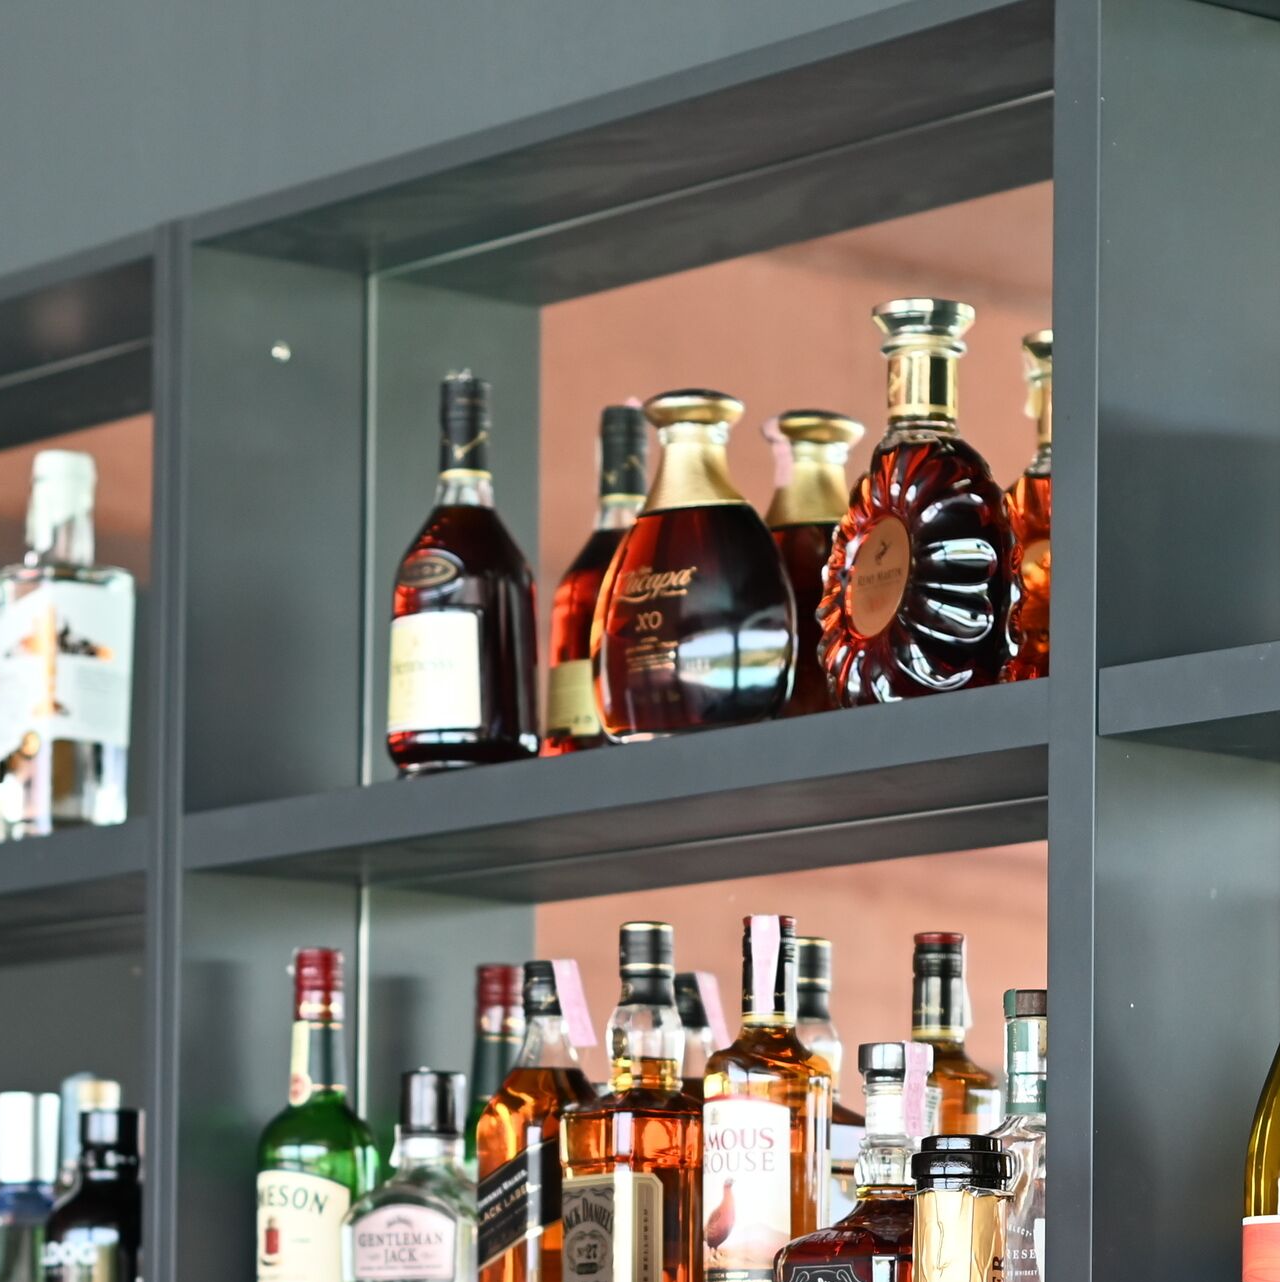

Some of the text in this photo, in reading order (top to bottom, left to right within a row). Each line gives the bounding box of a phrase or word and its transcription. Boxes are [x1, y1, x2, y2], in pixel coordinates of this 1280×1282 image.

[635, 611, 662, 631] XO
[704, 1128, 774, 1151] MOUS
[704, 1152, 775, 1174] ROUSE
[357, 1231, 444, 1248] GENTLEMAN
[1008, 1224, 1030, 1238] ELECT
[384, 1249, 418, 1263] JACK
